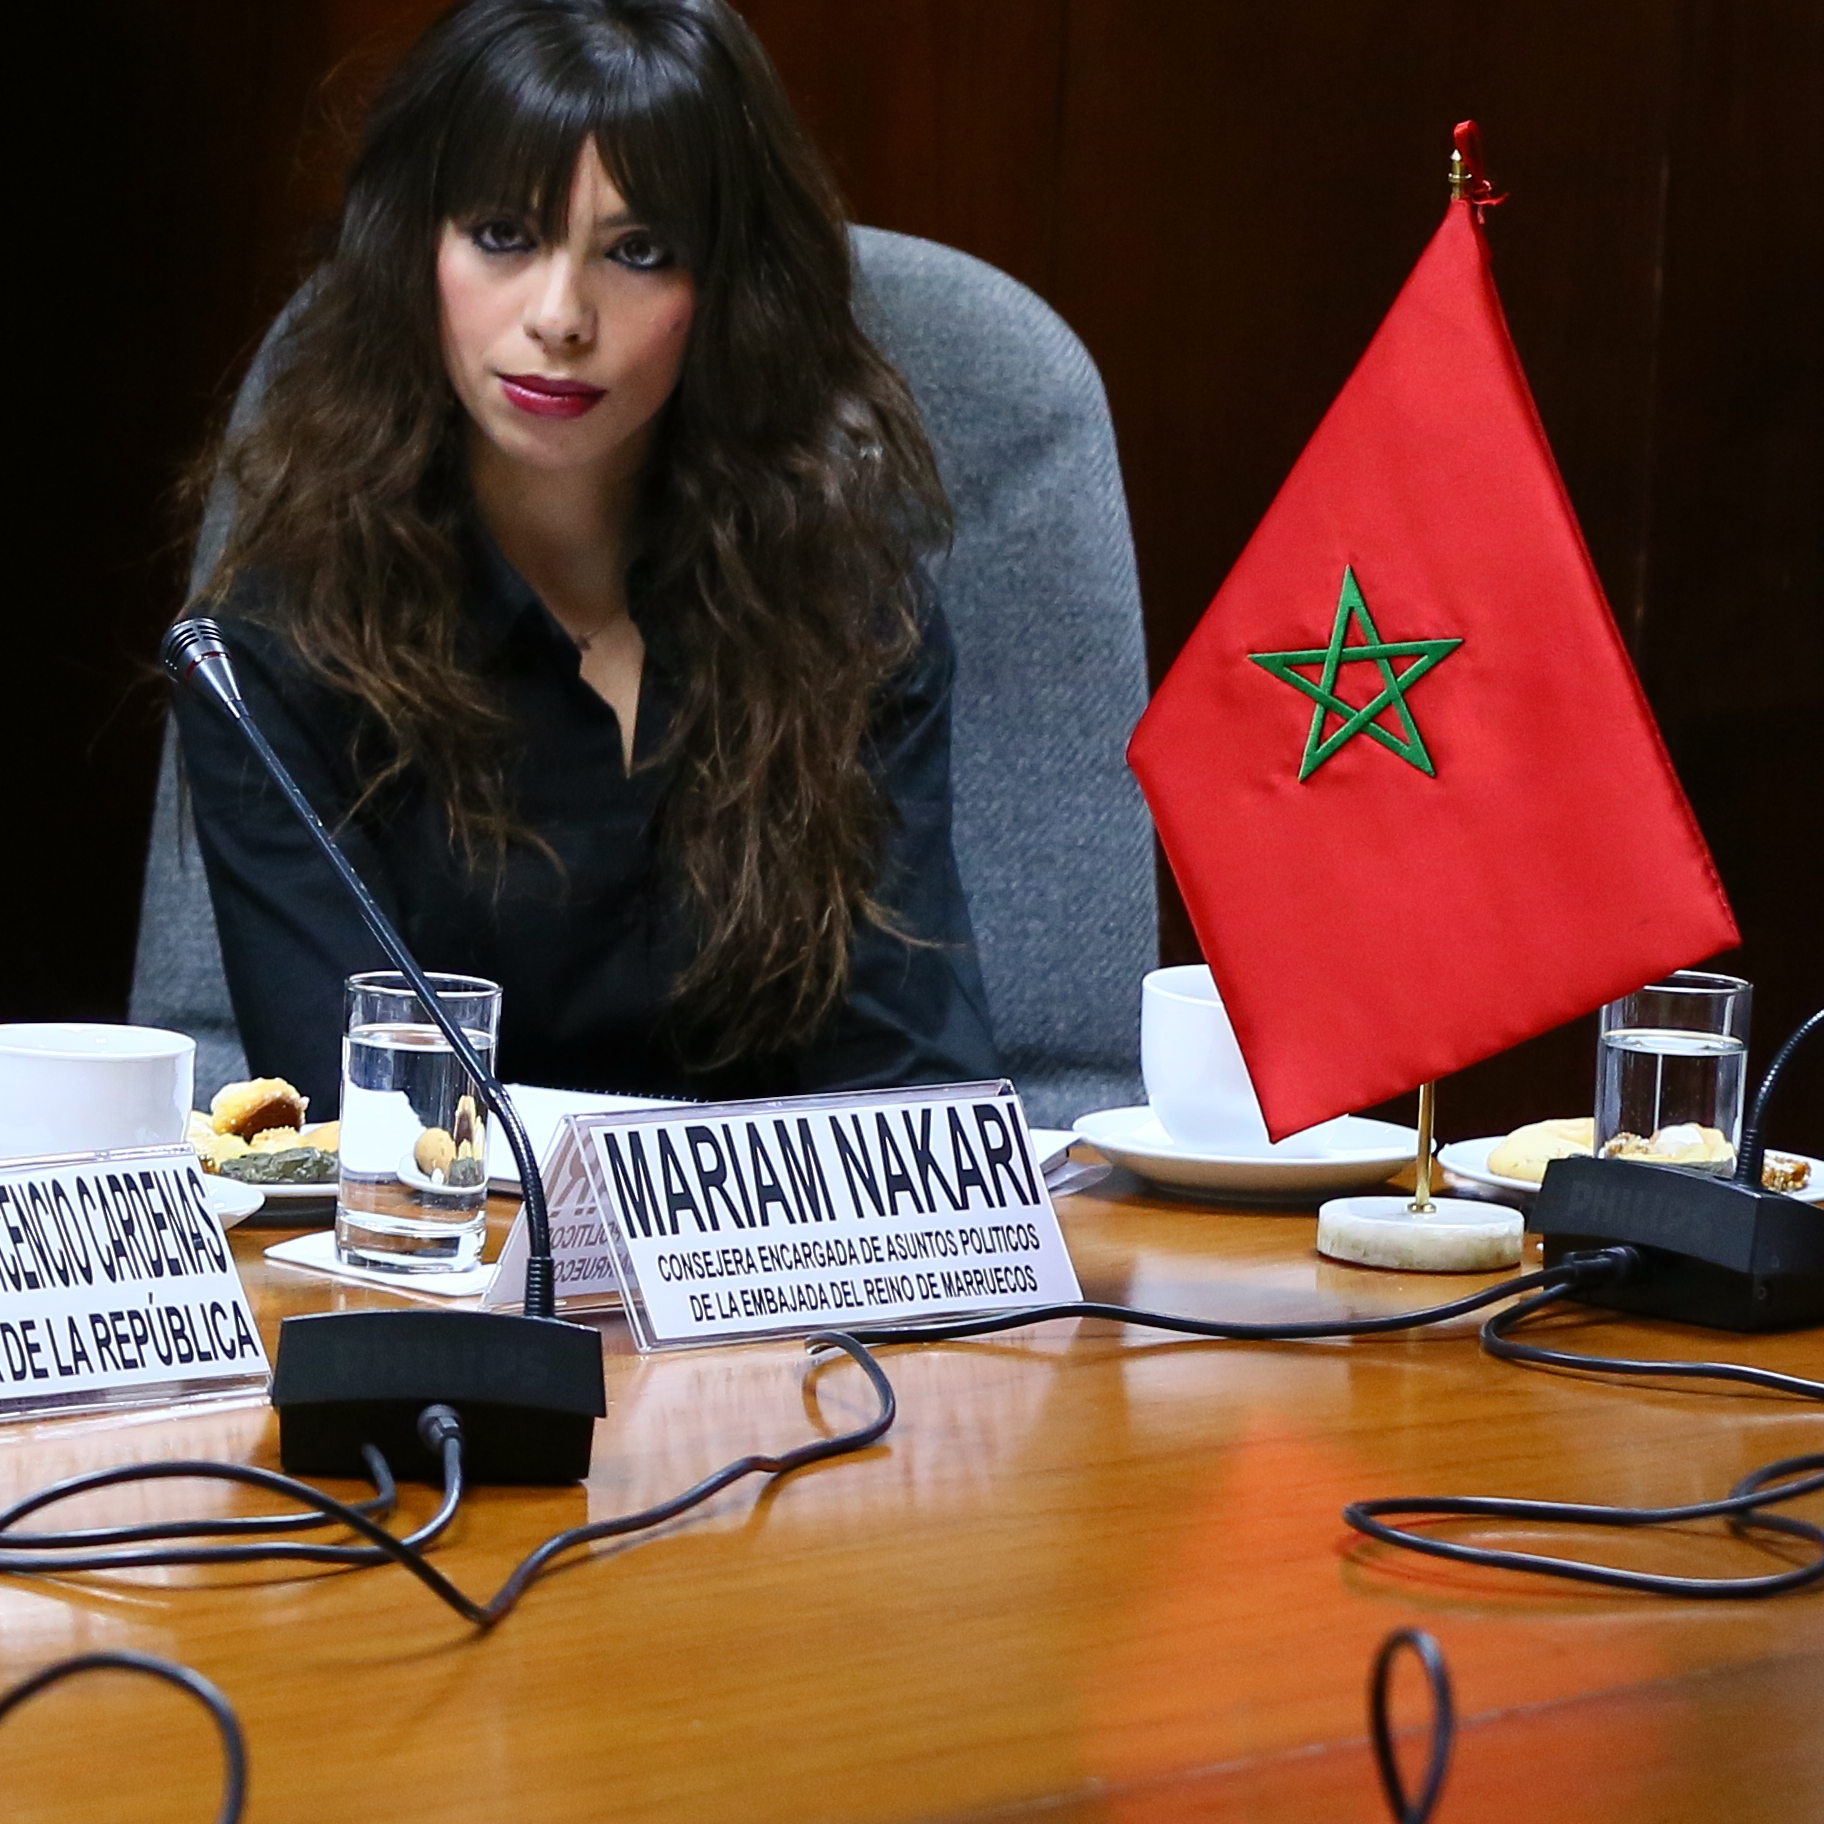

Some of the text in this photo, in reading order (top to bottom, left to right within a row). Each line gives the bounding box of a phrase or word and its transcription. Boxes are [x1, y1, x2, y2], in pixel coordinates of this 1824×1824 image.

[604, 1118, 836, 1238] MARIAM
[829, 1102, 1040, 1218] NAKARI
[77, 1167, 227, 1282] CARDENAS
[658, 1224, 1039, 1281] CONSEJERA ENCARGADA DE ASUNTOS POLITICOS
[0, 1320, 49, 1381] DE
[46, 1316, 94, 1376] LA
[90, 1293, 259, 1371] REPÚBLICA
[690, 1265, 1037, 1321] DE LA EMBAJADA DEL REINO DE MARRUECOS
